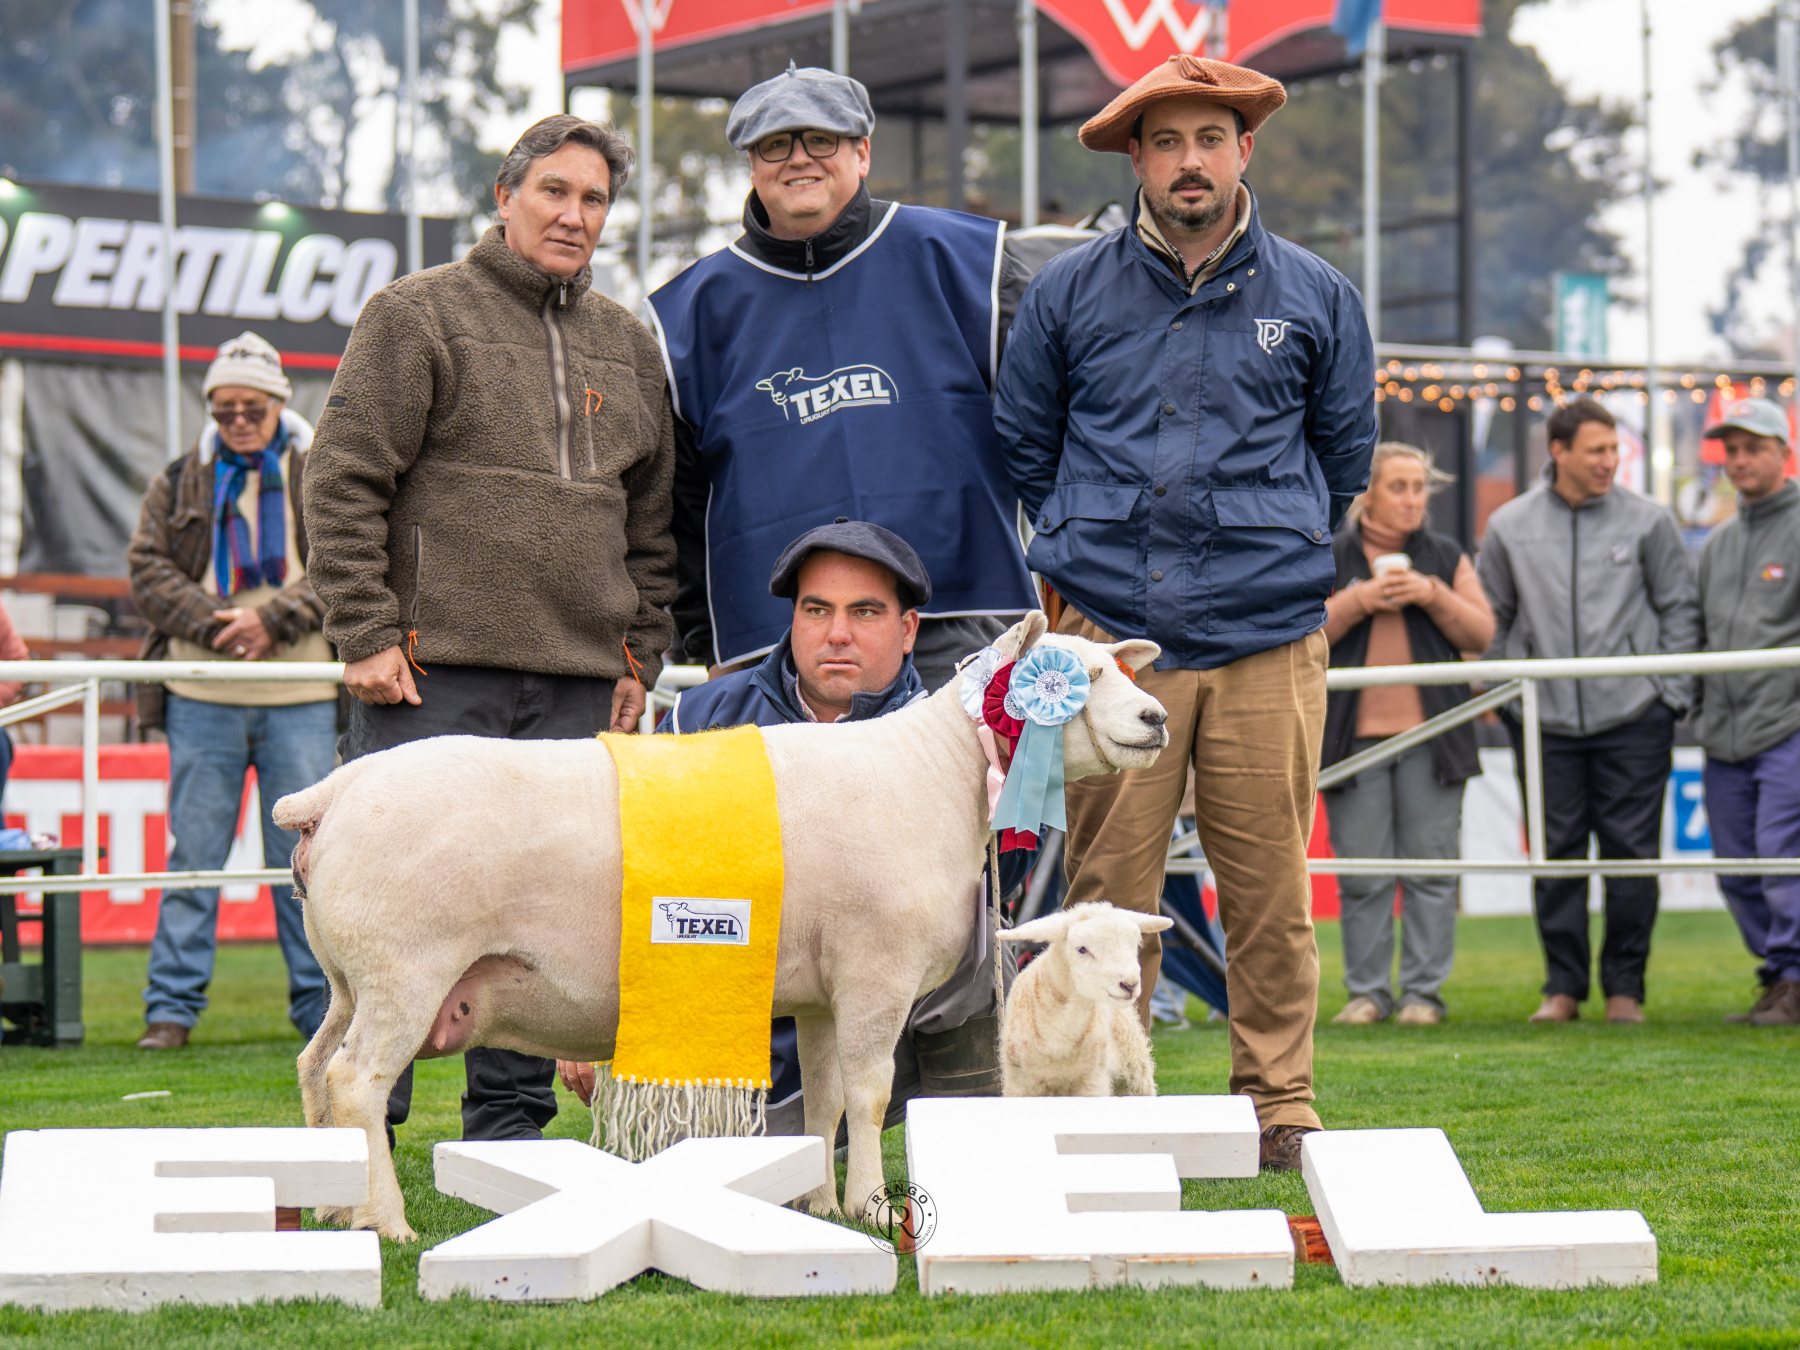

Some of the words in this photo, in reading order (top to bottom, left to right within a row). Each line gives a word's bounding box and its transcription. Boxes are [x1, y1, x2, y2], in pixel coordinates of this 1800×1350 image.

[789, 373, 891, 418] TEXEL
[800, 408, 832, 425] URUGUAY
[676, 918, 738, 935] TEXEL
